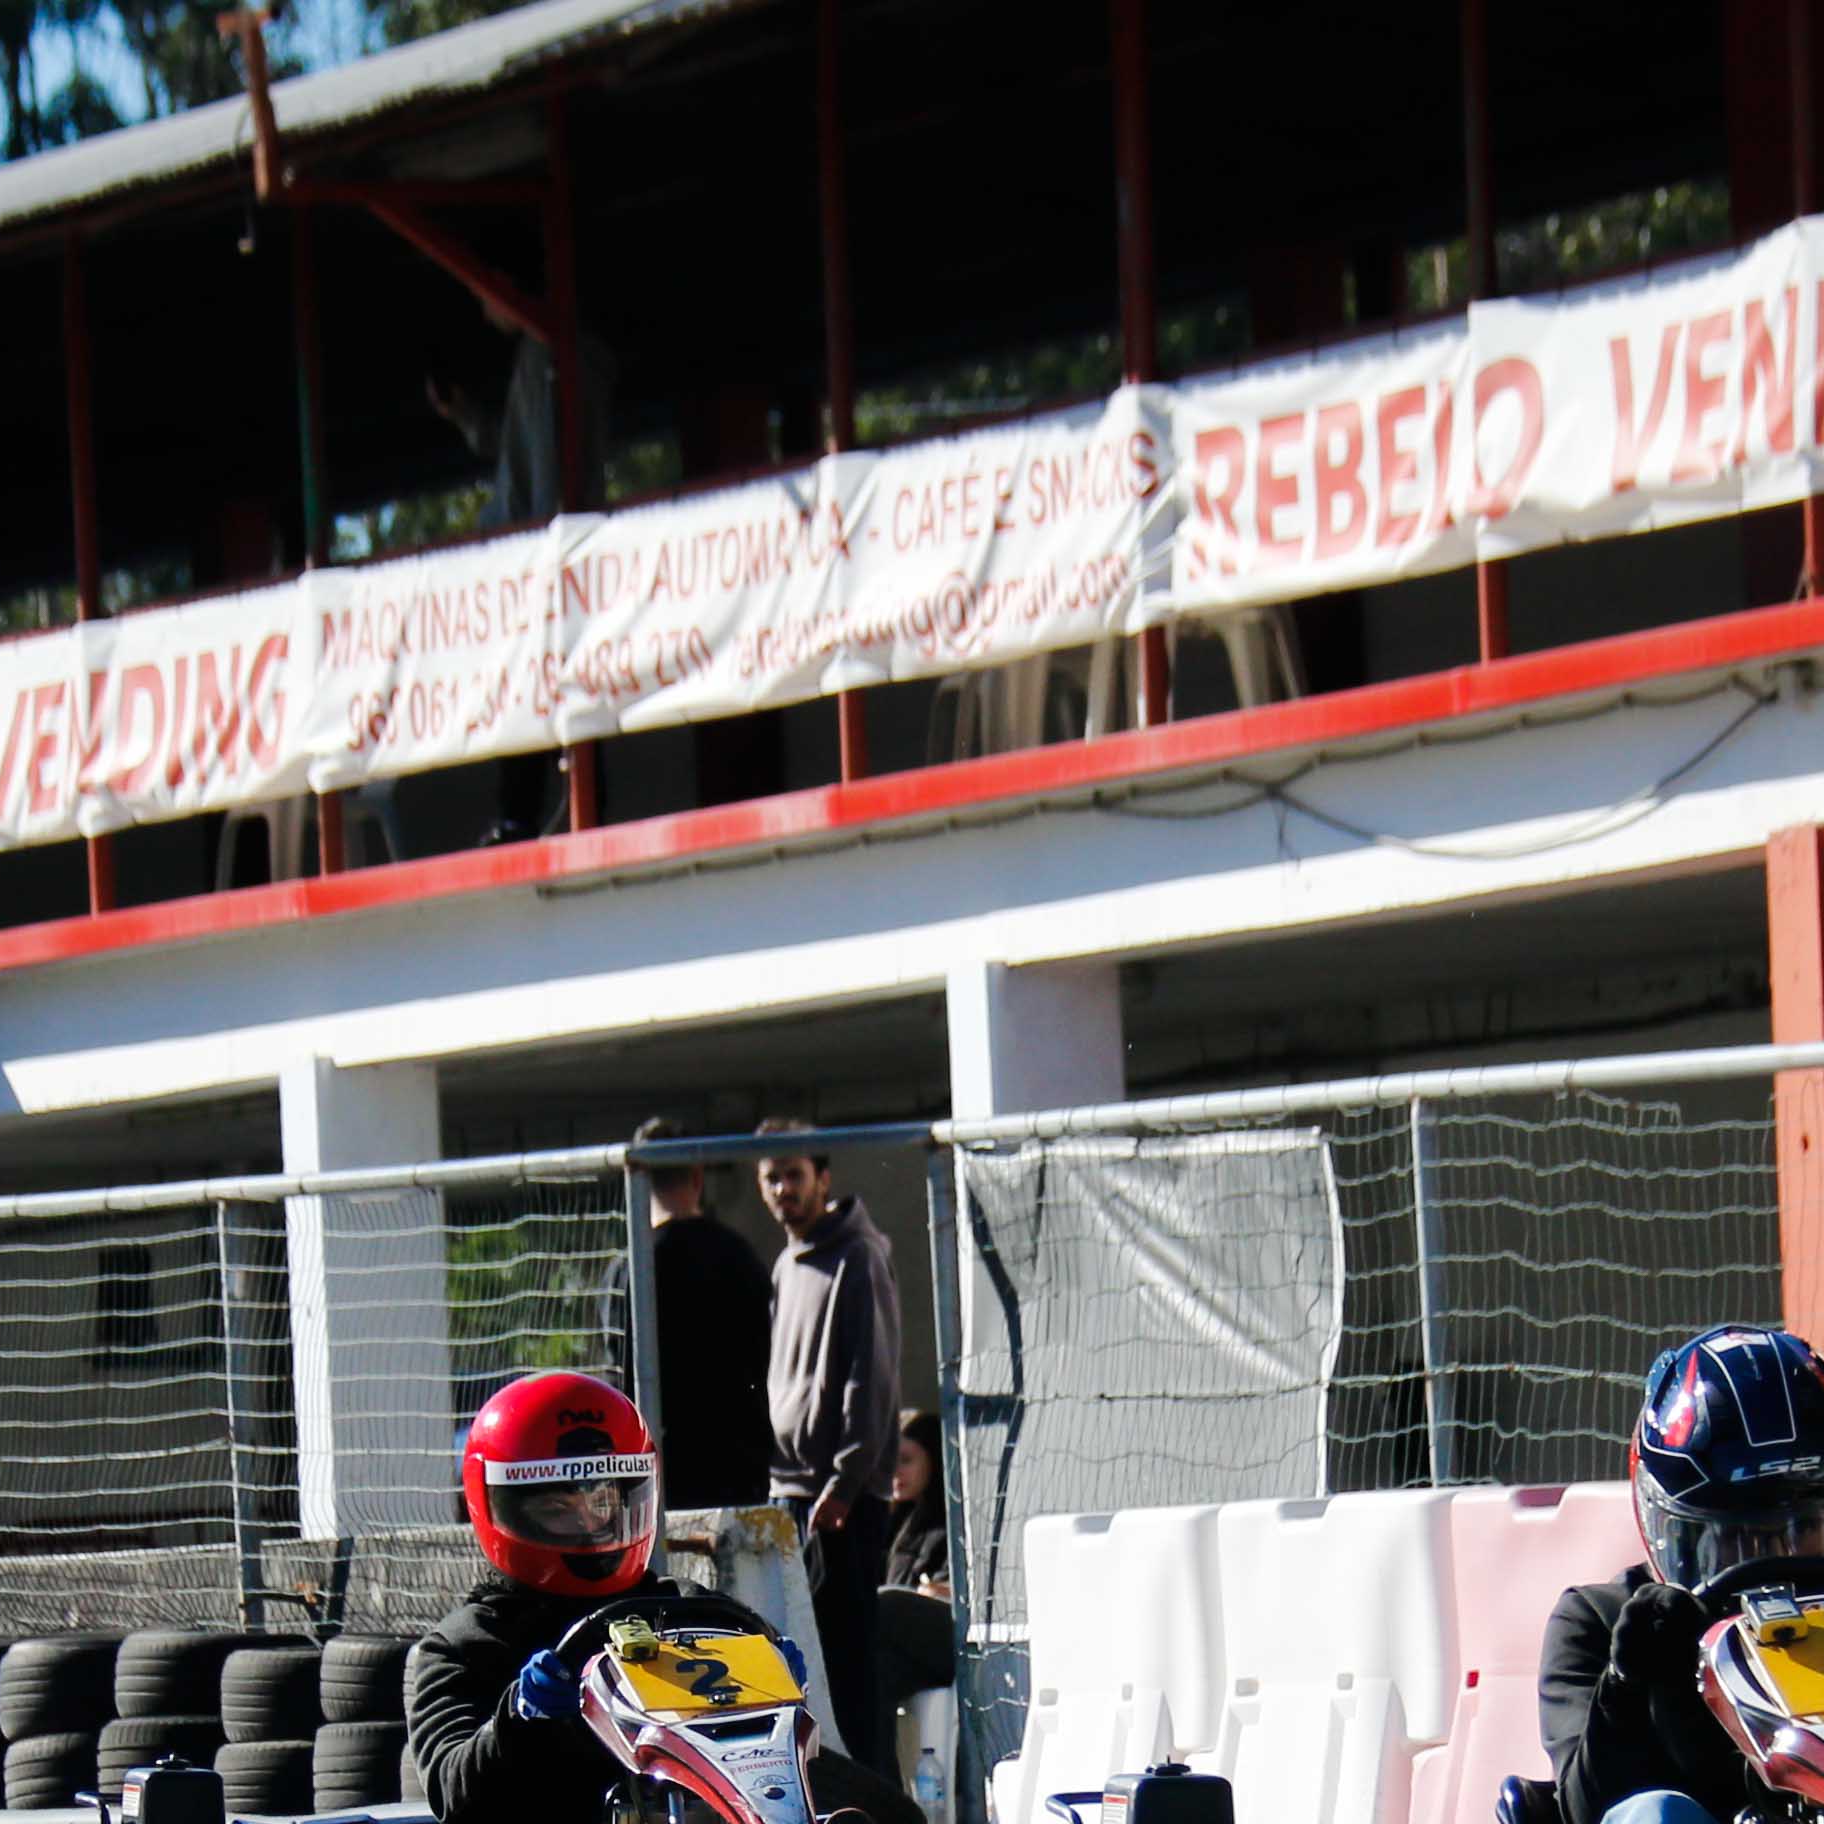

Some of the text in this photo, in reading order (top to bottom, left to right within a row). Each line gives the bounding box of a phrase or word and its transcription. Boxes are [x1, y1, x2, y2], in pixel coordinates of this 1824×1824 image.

[893, 458, 981, 553] CAFÉ
[993, 466, 1015, 532] E
[1027, 431, 1159, 528] SNACKS
[529, 650, 568, 718] 26
[1729, 1455, 1822, 1483] LS2
[675, 1659, 744, 1698] 2
